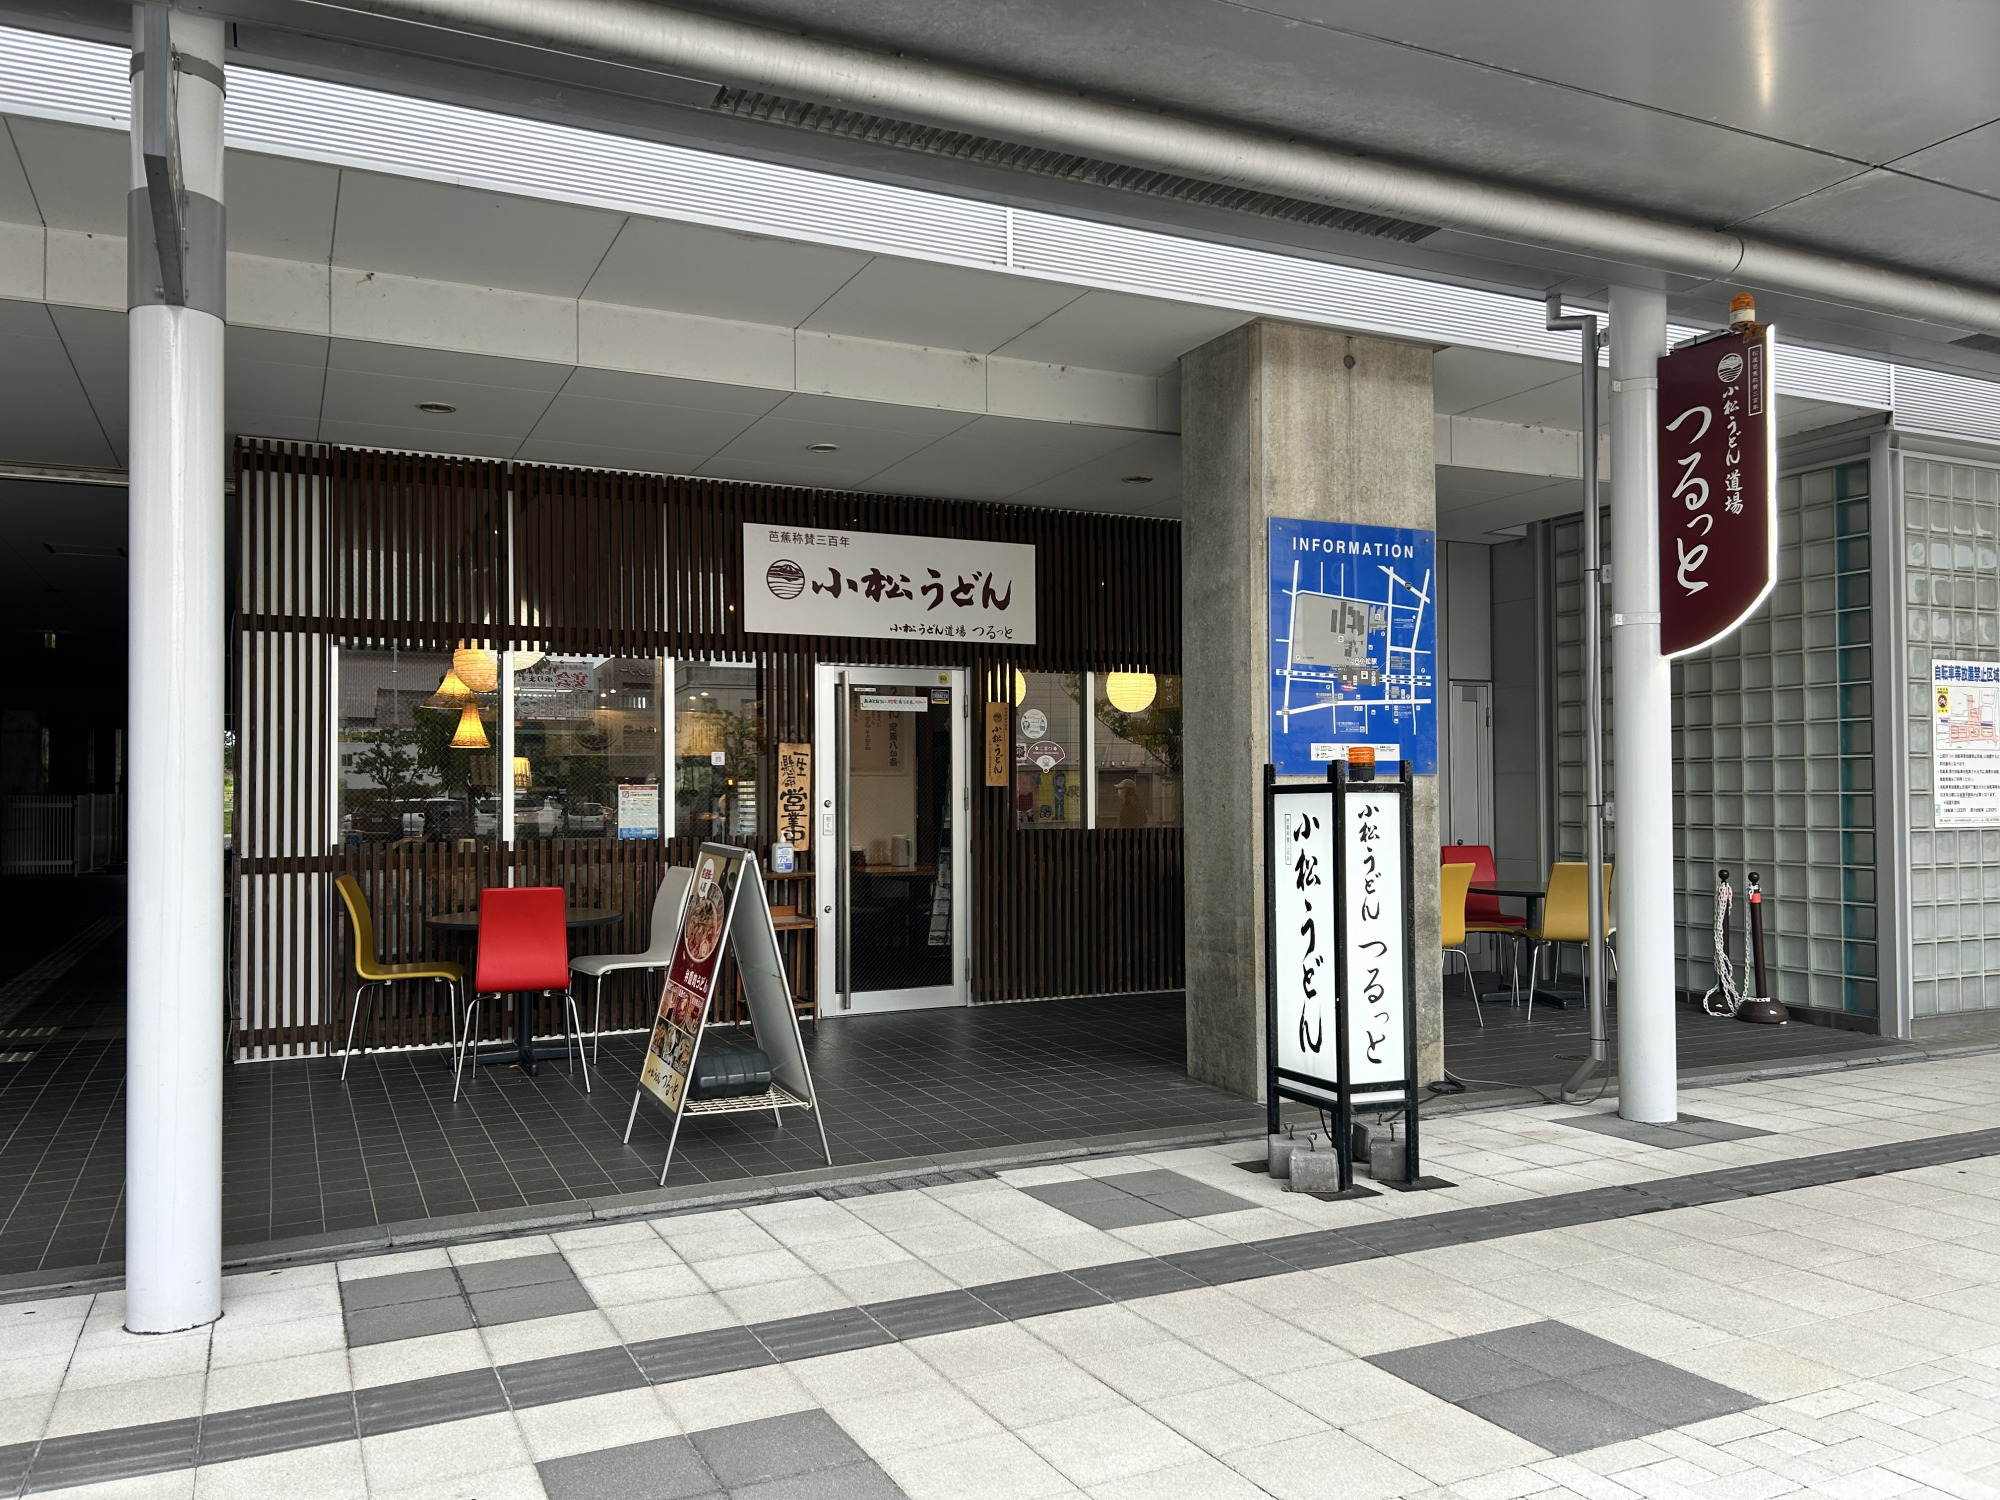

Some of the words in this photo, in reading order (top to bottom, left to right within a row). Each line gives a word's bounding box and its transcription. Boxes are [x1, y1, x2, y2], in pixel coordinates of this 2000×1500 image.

[1722, 386, 1743, 515] 小松うどん道場
[1665, 405, 1713, 596] つるっと
[768, 530, 850, 547] 芭蕉称賛三百年
[1292, 537, 1414, 559] INFORMATION
[812, 567, 1012, 611] 小松うどん
[889, 623, 966, 637] 小松うどん道場
[972, 625, 1013, 640] つるっと
[1935, 665, 2000, 682] 自転車等放置禁止区域
[780, 786, 808, 850] 営業中
[1358, 804, 1382, 921] 小松うどん
[1294, 813, 1323, 1054] 小松うどん
[1358, 940, 1390, 1064] つるっと
